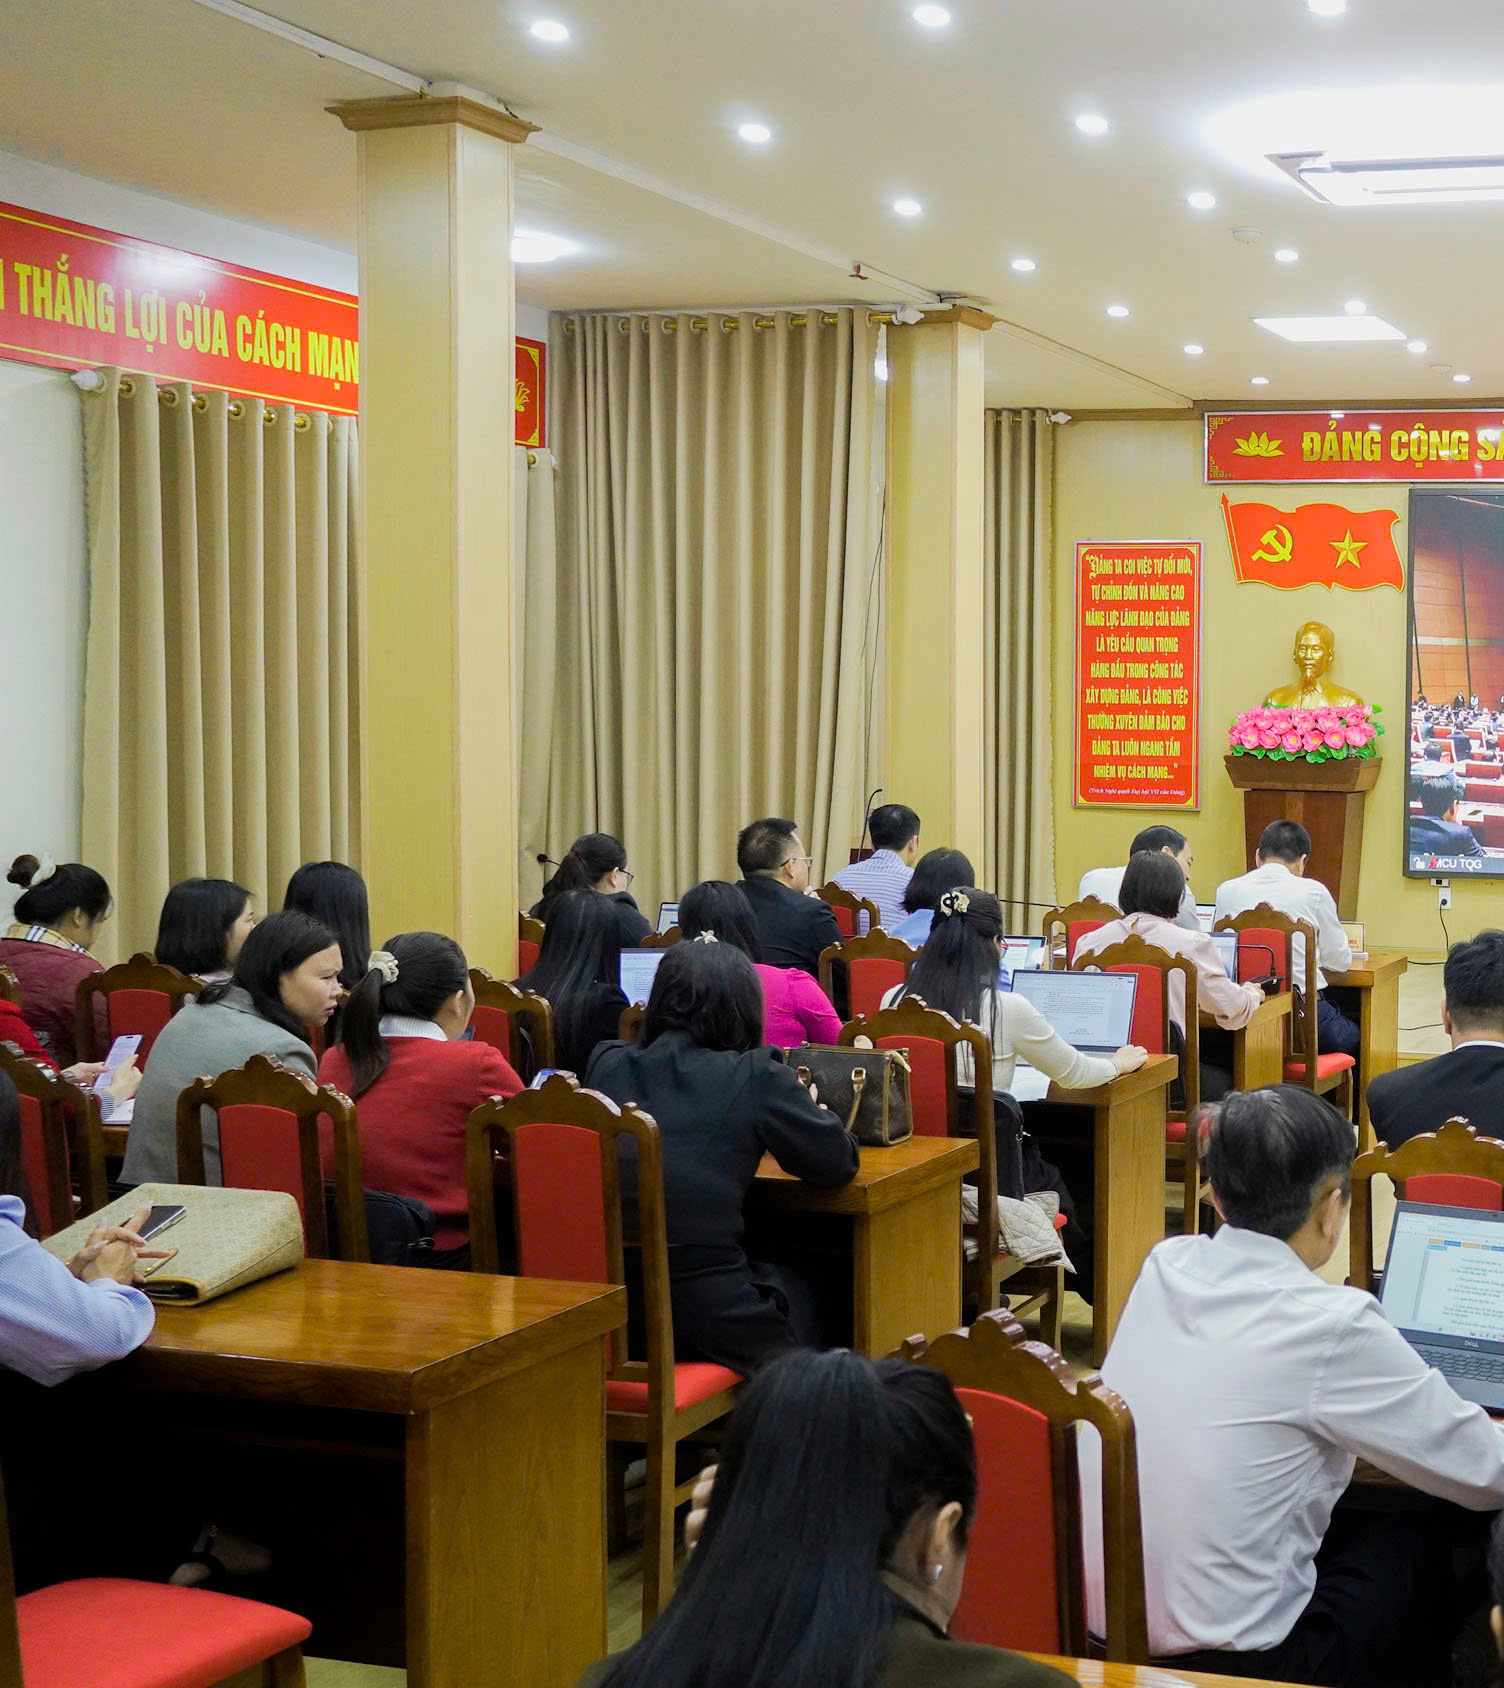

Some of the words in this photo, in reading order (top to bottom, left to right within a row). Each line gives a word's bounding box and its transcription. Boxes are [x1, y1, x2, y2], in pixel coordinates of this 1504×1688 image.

[14, 254, 116, 334] THẮNG
[124, 288, 168, 353] LỢI
[176, 290, 229, 358] CỦA
[236, 309, 301, 373] CÁCH
[1302, 420, 1382, 462] ĐẢNG
[1390, 422, 1469, 468] CỘNG
[1460, 858, 1483, 871] TQG
